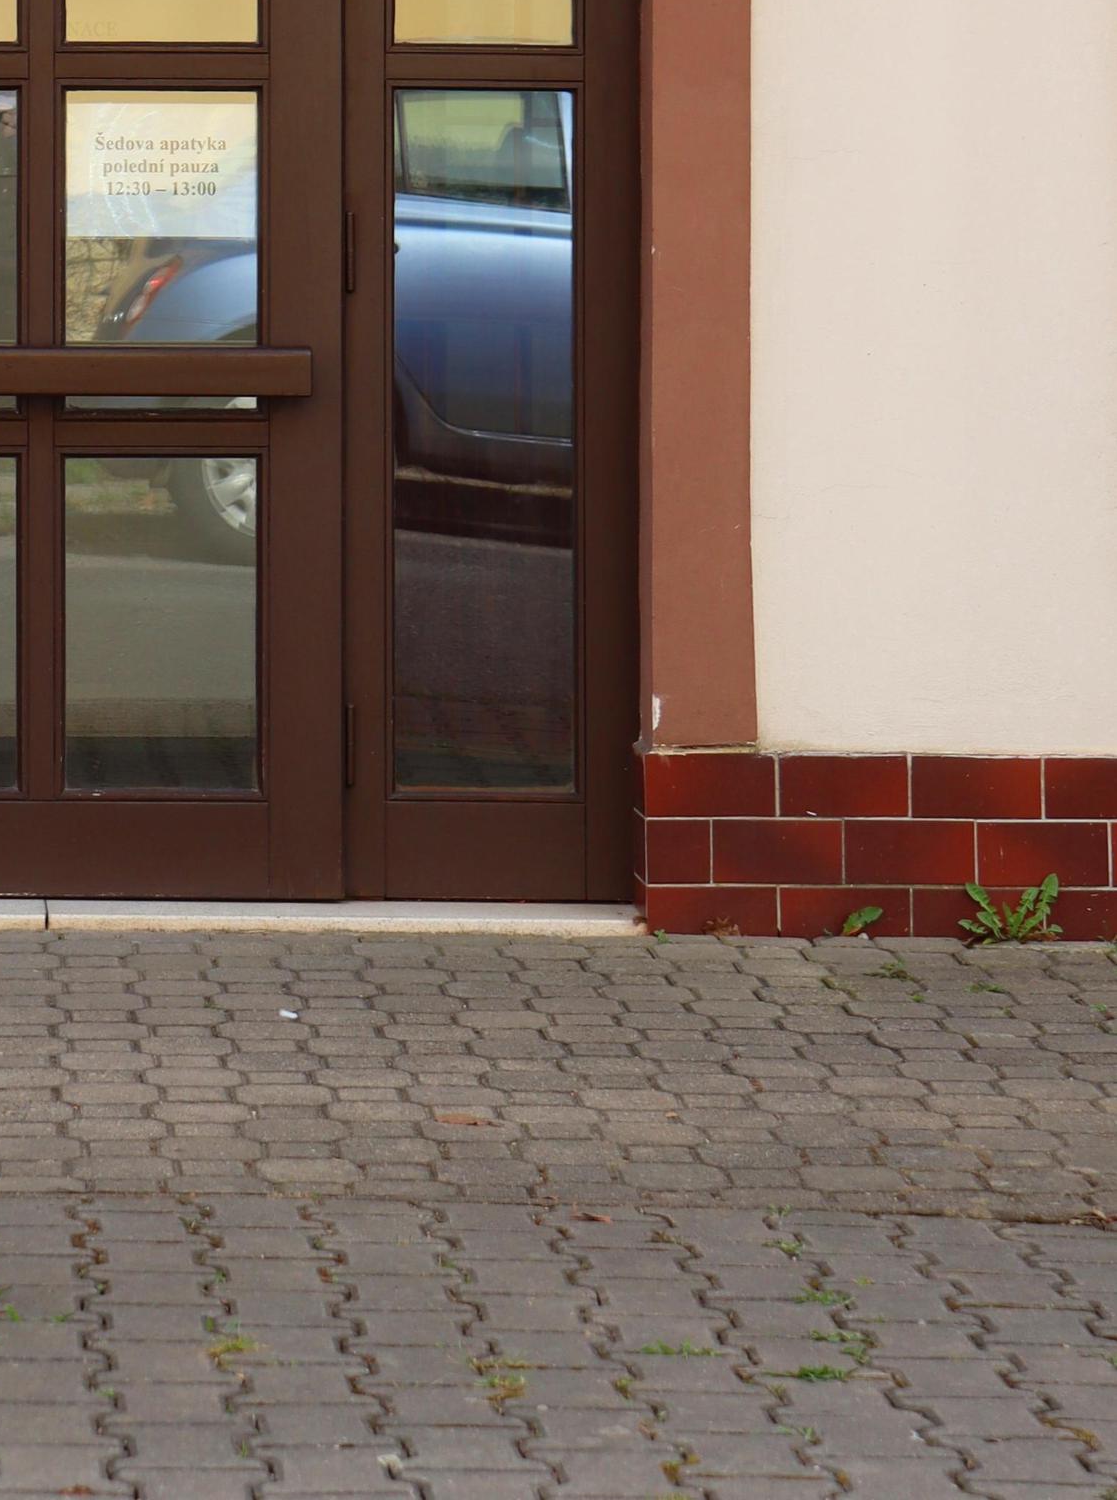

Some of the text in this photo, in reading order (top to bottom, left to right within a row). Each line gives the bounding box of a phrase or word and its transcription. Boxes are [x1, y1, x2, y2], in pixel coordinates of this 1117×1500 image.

[94, 132, 227, 154] Šedova apatyka
[102, 159, 219, 177] polední pauza
[107, 181, 151, 196] 12:30
[172, 182, 217, 196] 13:00
